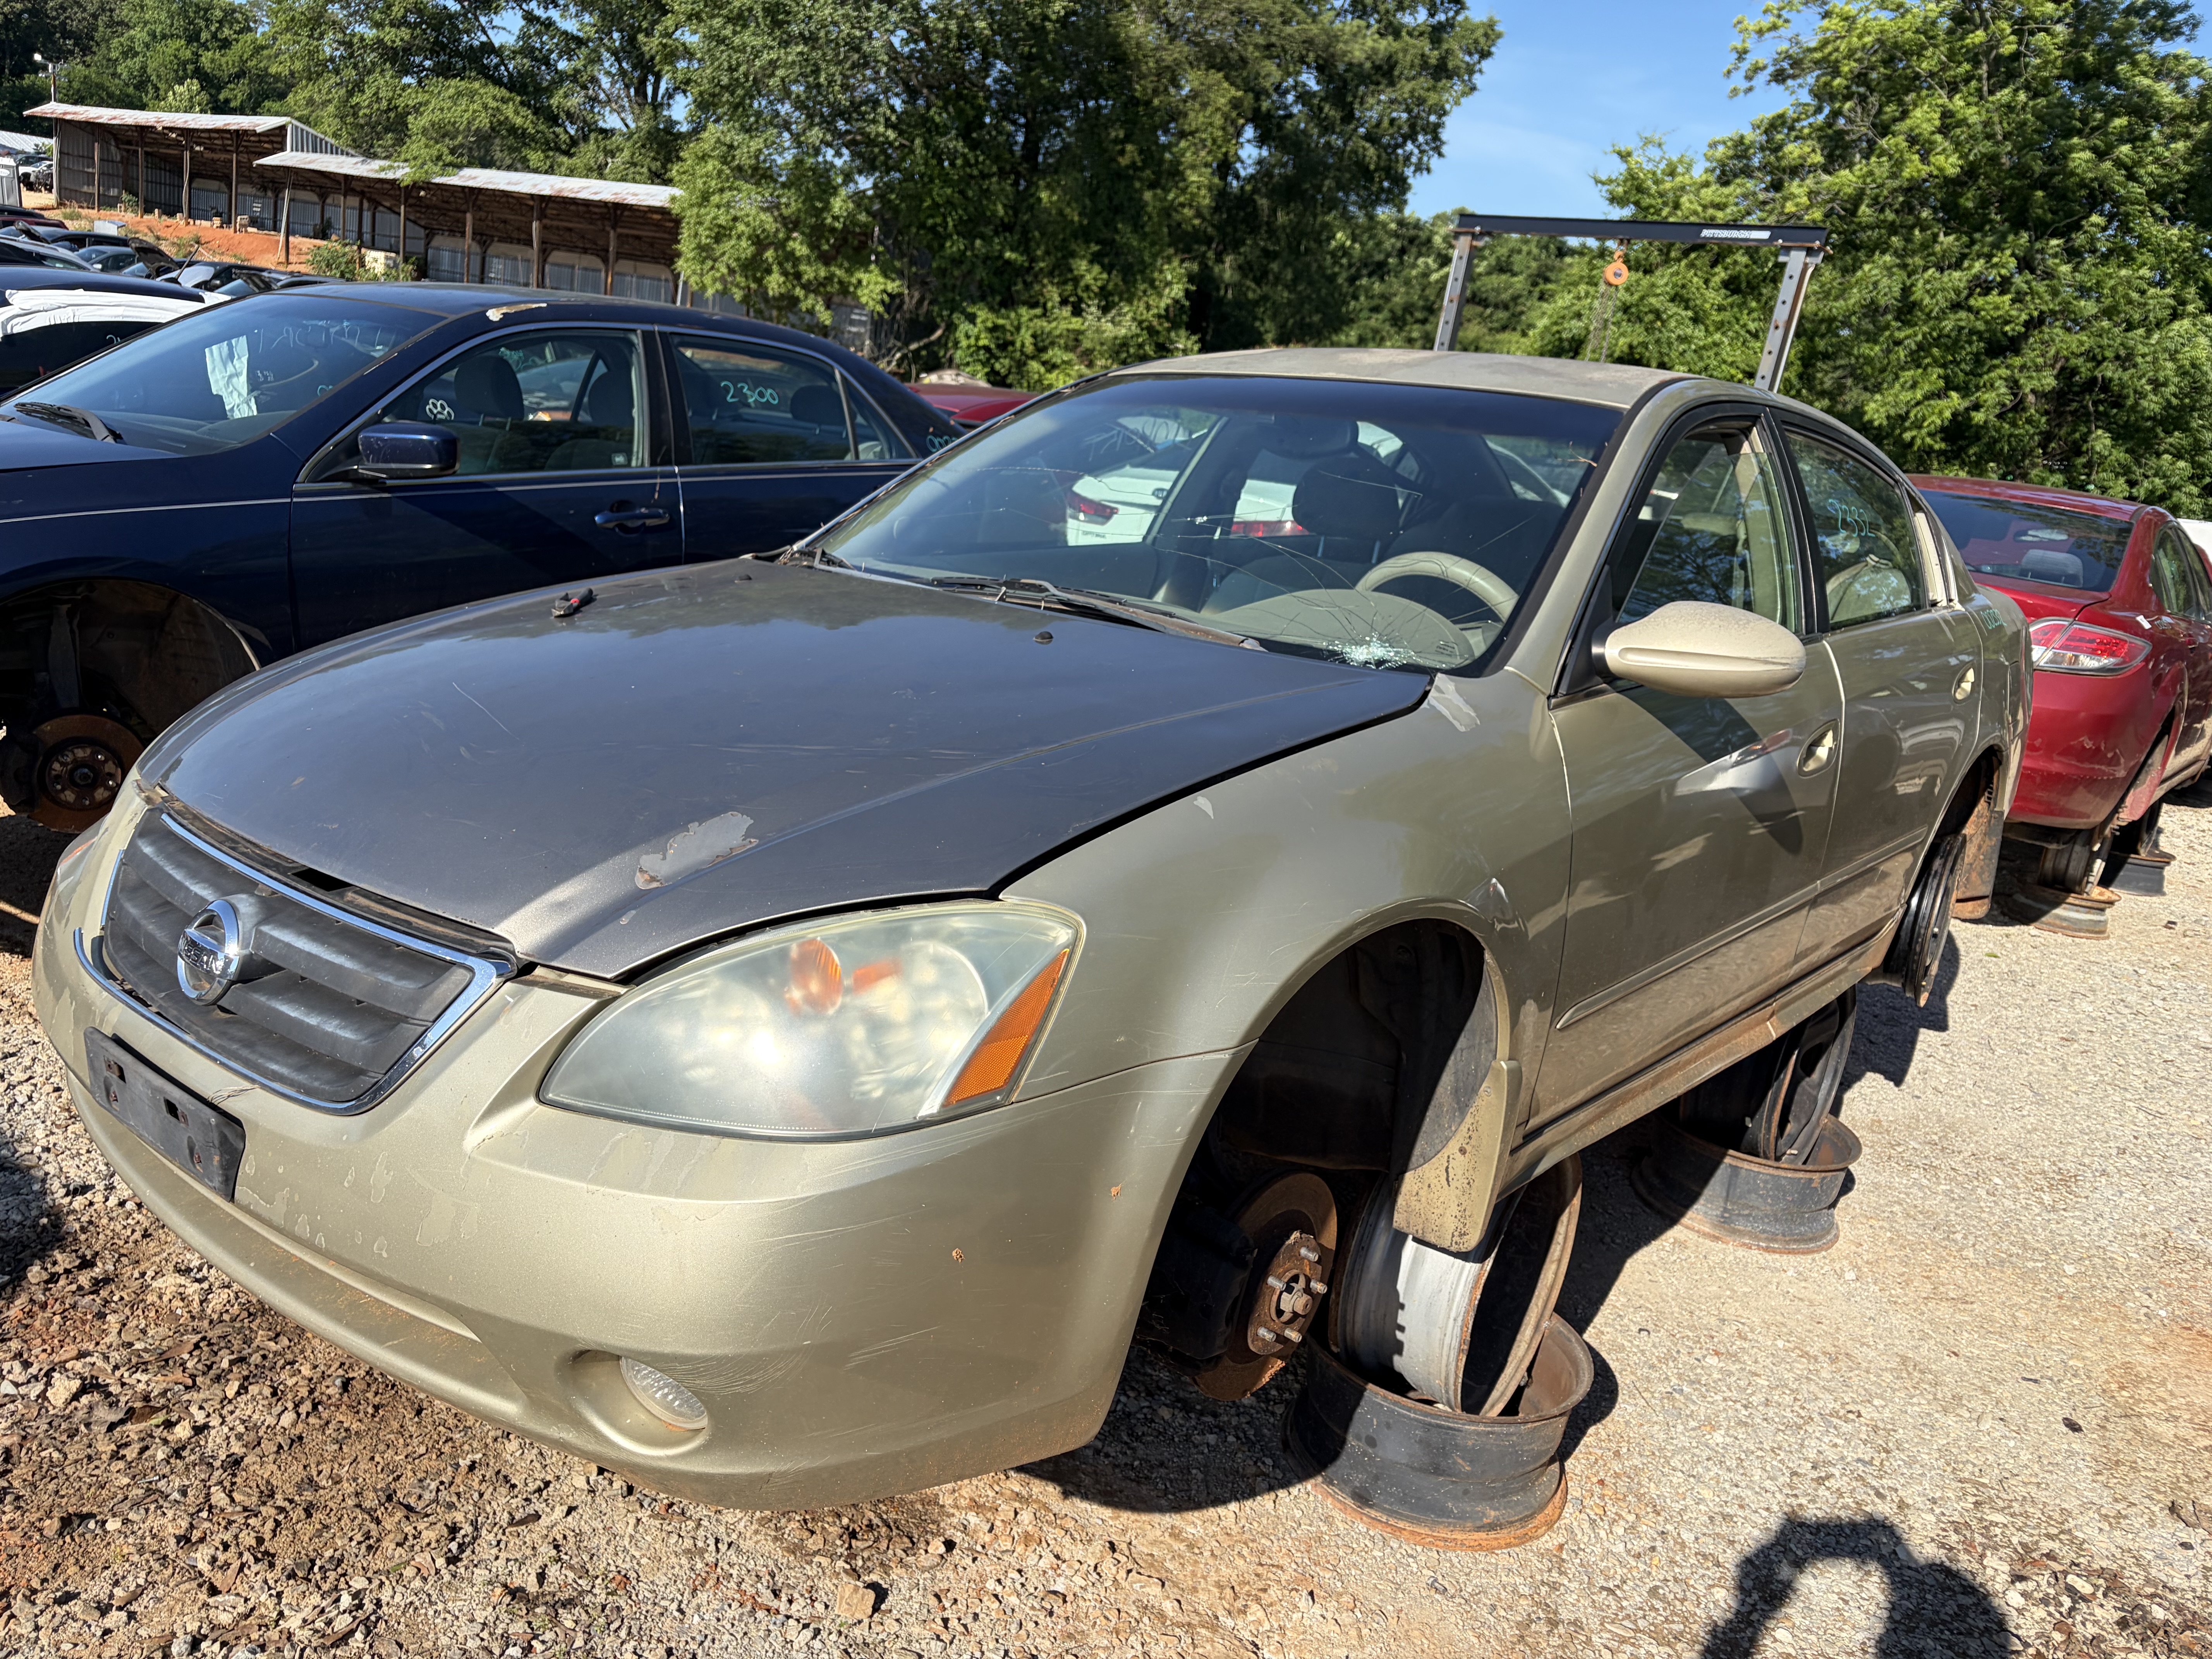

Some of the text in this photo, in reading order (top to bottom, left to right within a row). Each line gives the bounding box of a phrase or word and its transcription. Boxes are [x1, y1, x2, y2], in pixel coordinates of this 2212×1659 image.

[1700, 229, 1752, 239] PITTSBURGH
[720, 381, 778, 404] 2300
[1829, 498, 1876, 537] 2332
